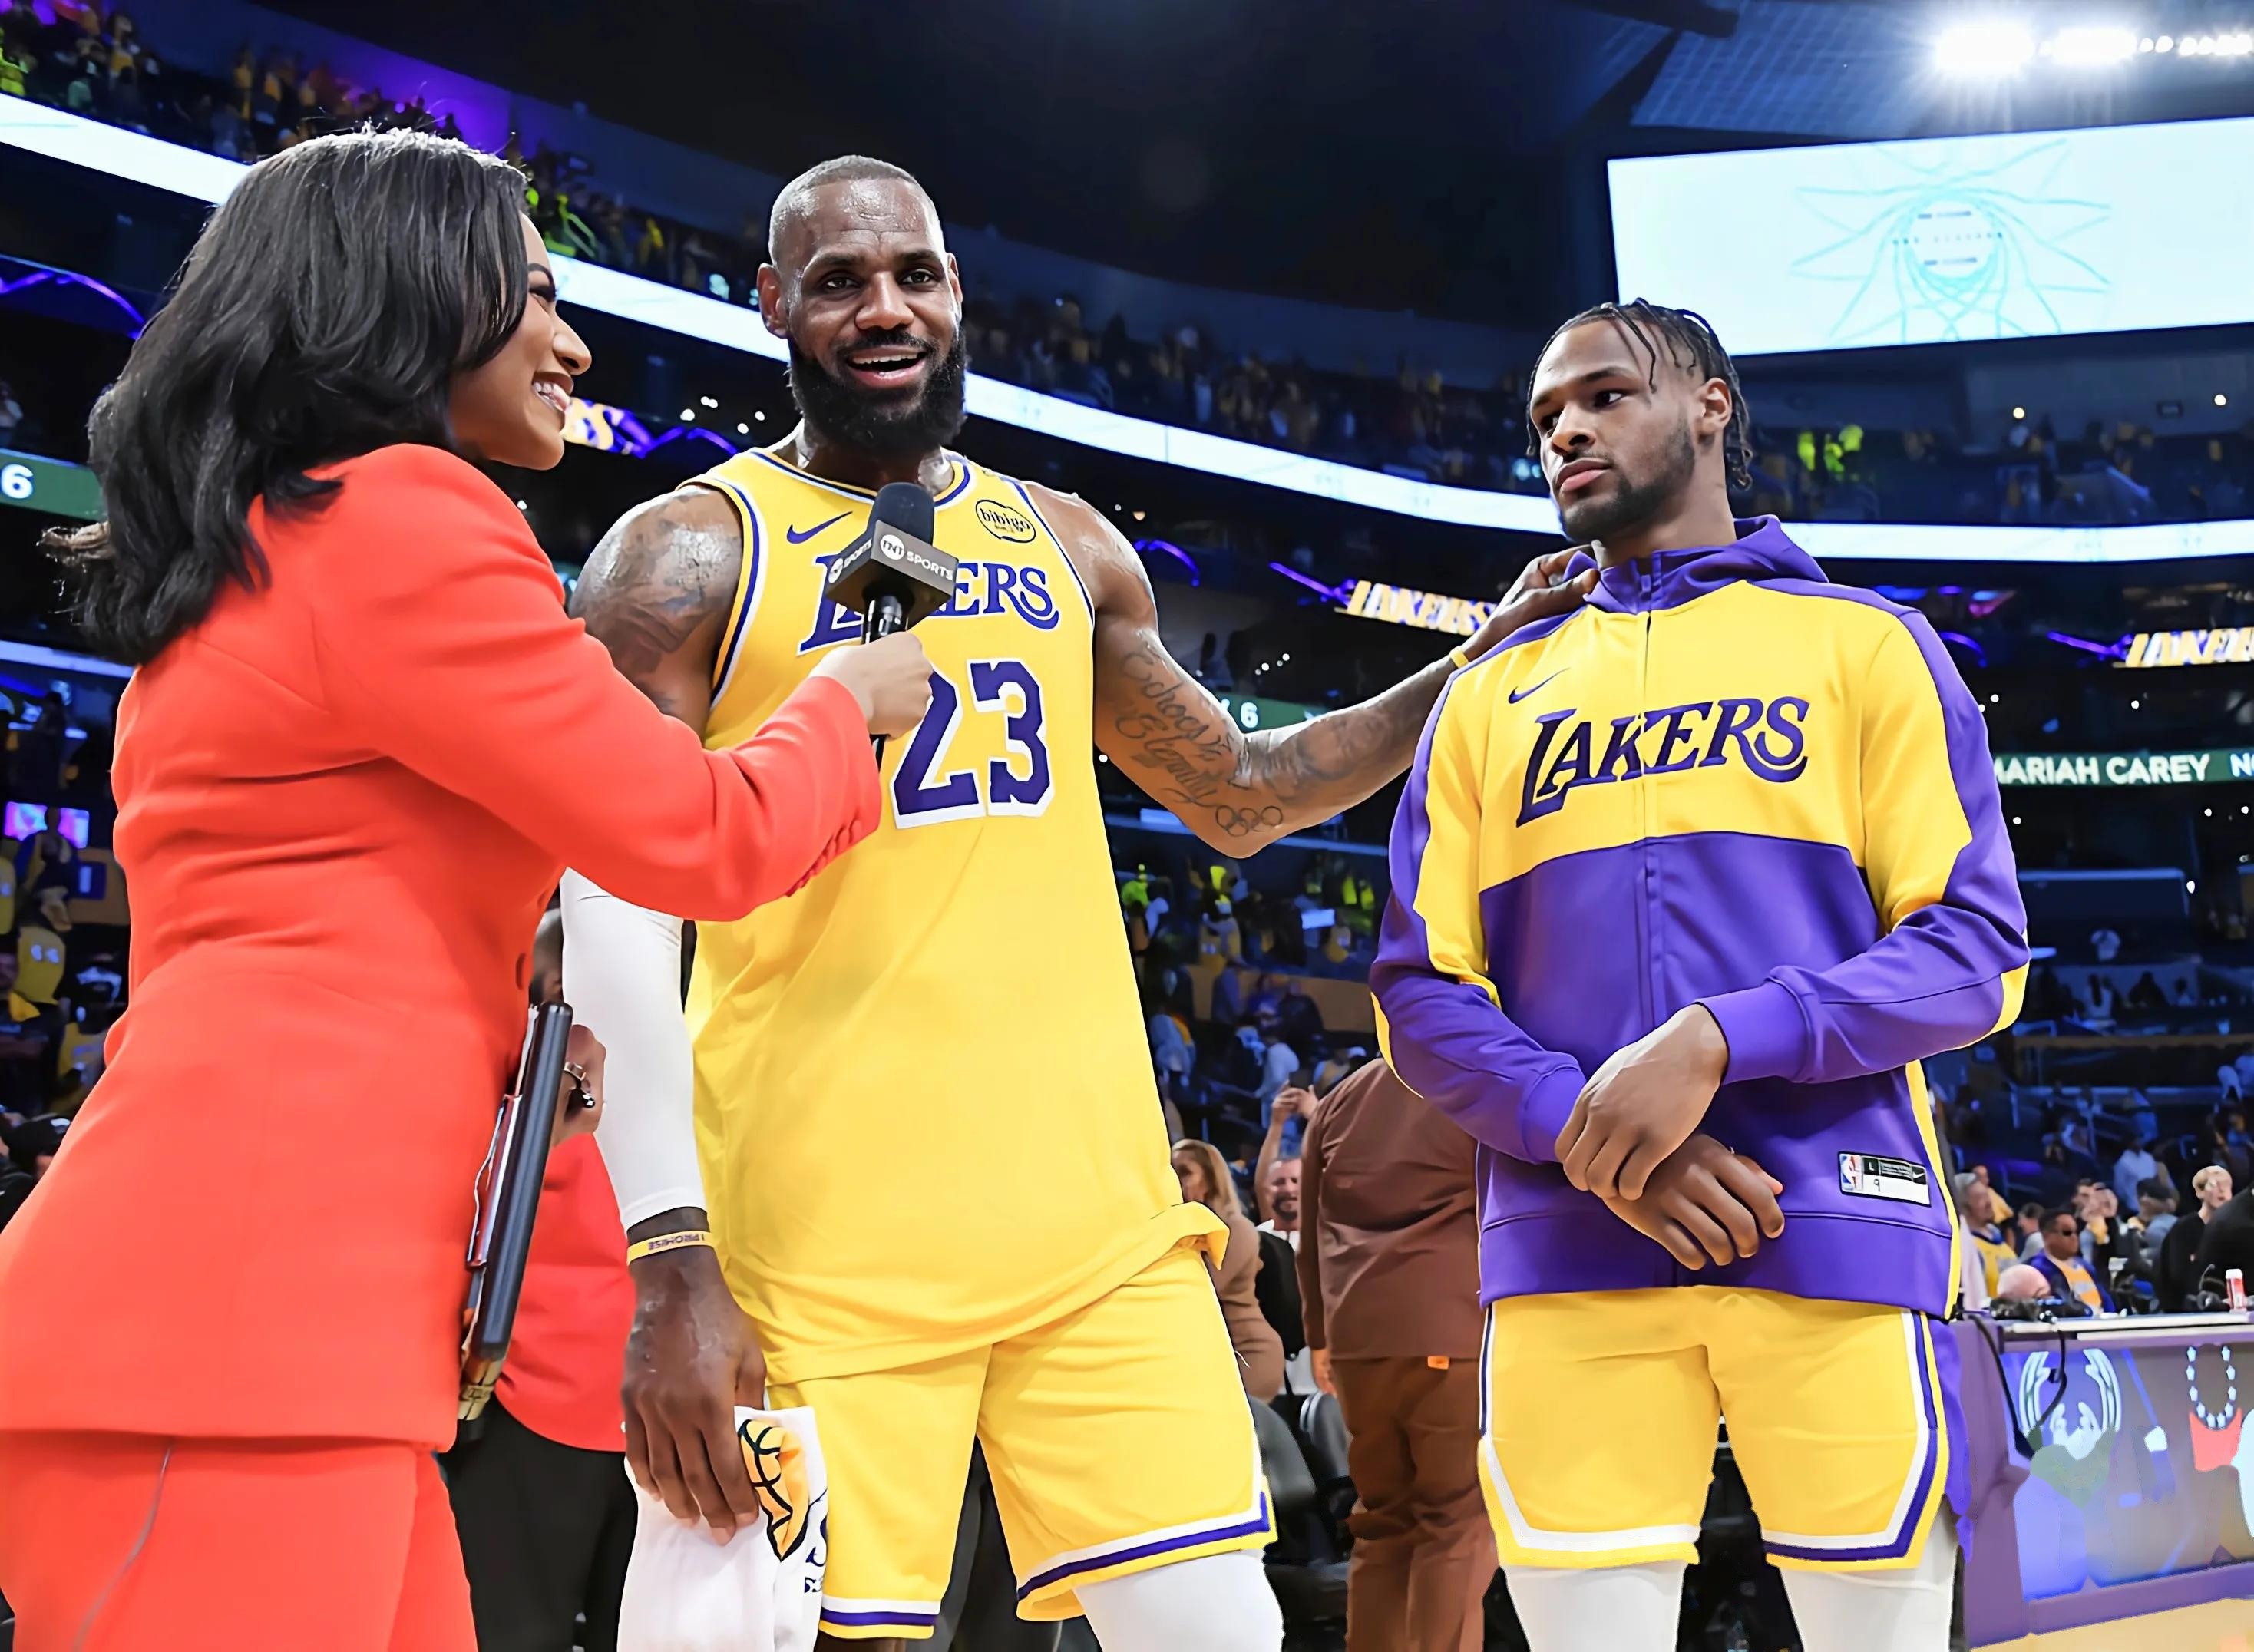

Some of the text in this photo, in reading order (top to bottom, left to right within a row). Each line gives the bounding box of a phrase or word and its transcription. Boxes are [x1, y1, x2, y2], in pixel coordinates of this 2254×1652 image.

[1, 463, 35, 500] 6
[979, 507, 1031, 533] bibigo
[882, 539, 954, 582] TNT SPORTS
[799, 553, 1060, 653] LERS
[1239, 702, 1259, 729] 6
[889, 656, 1056, 830] 23
[1516, 695, 1810, 828] LAKERS
[2106, 753, 2210, 785] CAREY
[2230, 752, 2254, 778] N
